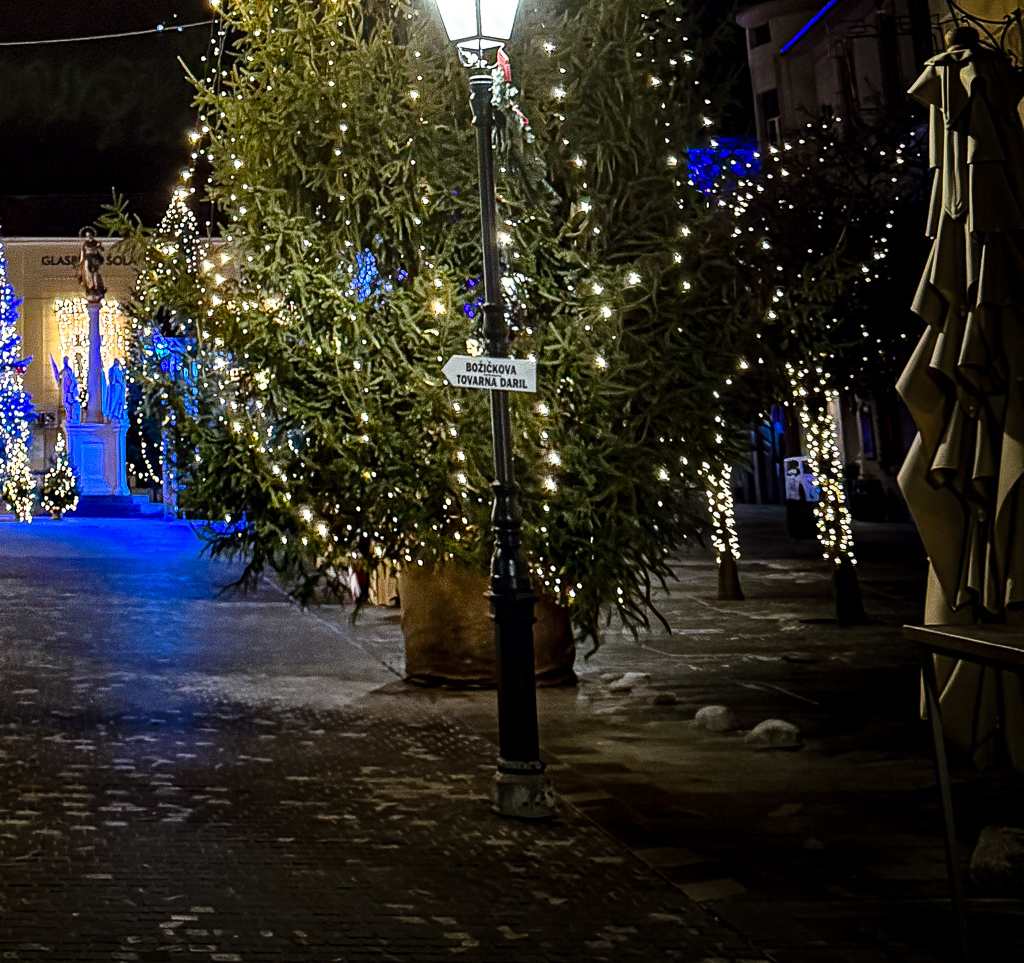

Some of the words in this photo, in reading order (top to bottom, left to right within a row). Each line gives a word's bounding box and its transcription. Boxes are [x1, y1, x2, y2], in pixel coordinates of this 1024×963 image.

[465, 360, 517, 375] BOŽIČKOVA
[457, 374, 497, 387] TOVARNA
[500, 378, 528, 389] DARIL
